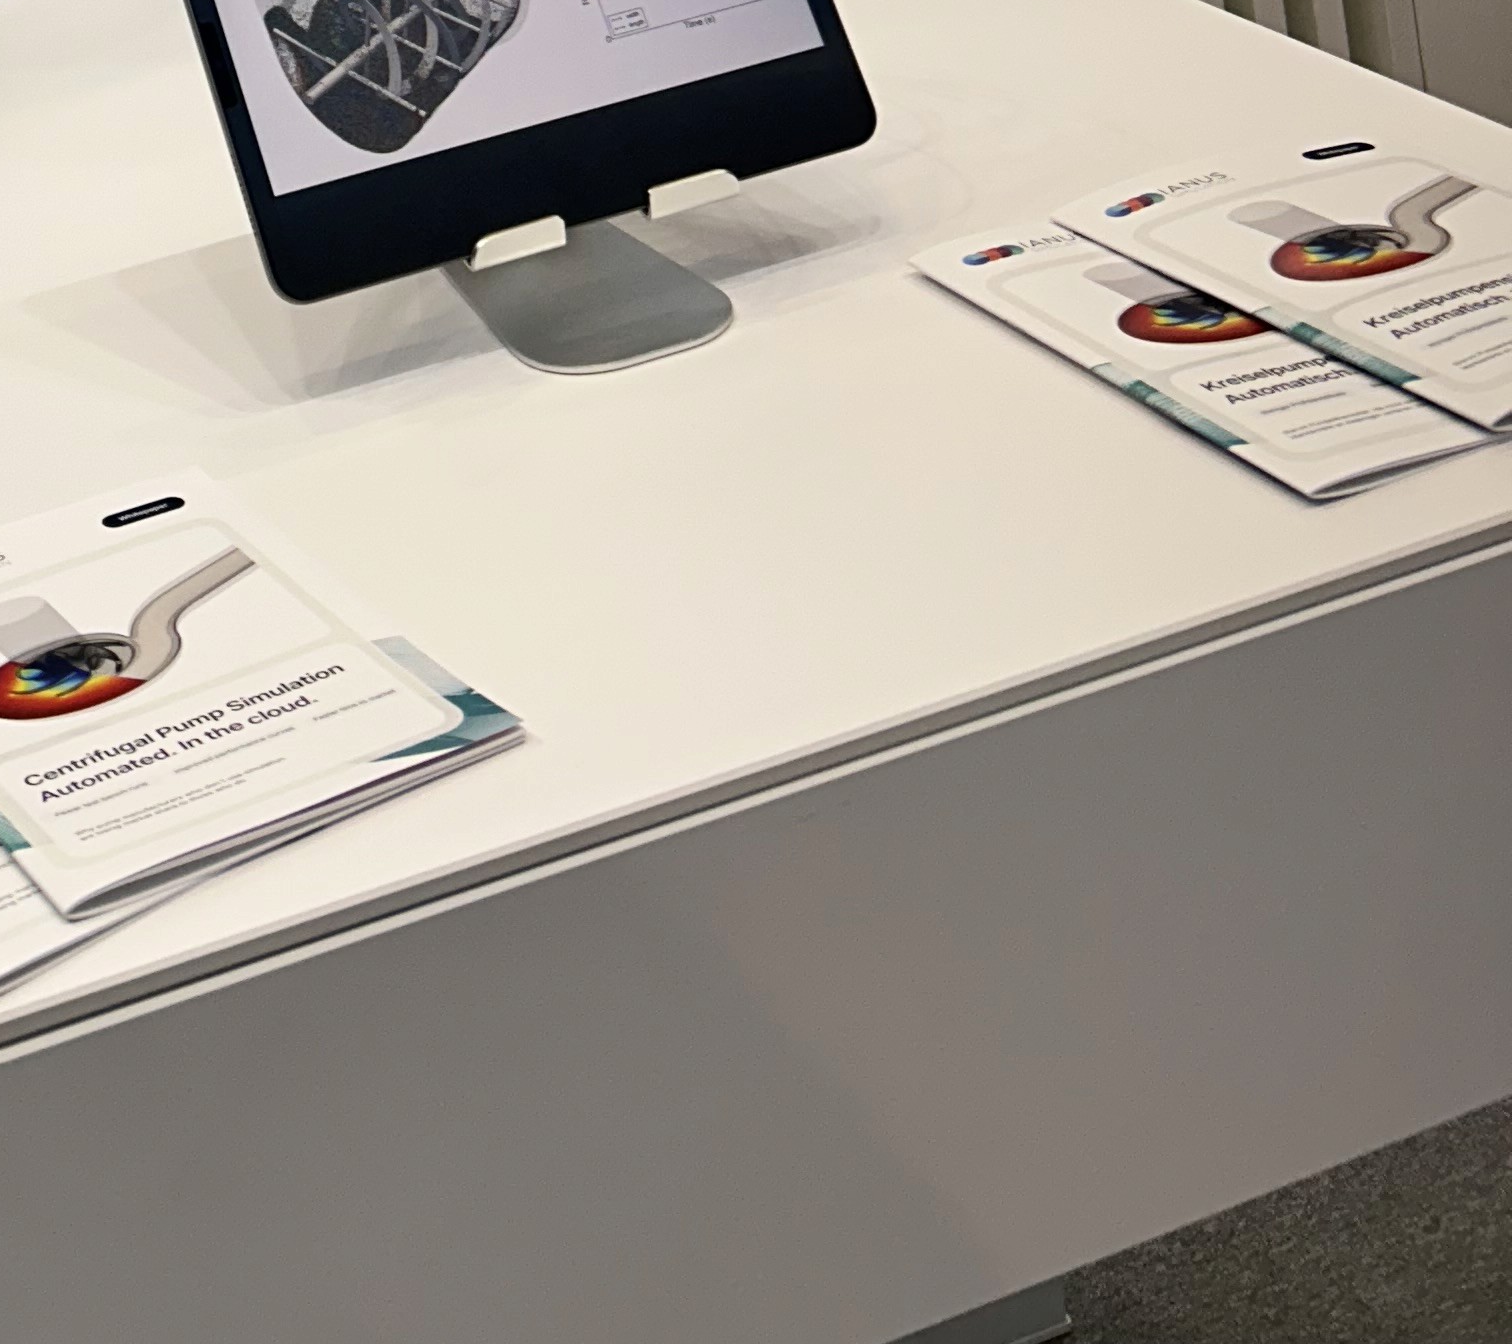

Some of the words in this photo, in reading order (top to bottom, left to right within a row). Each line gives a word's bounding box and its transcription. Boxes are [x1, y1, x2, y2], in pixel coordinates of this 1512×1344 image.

[1157, 171, 1228, 196] IANUS
[24, 732, 154, 787] Centrifugal
[156, 707, 225, 740] Pump
[226, 662, 345, 712] Simulation
[40, 747, 177, 803] Automated.
[178, 736, 197, 752] In
[204, 721, 245, 743] the
[247, 695, 319, 725] cloud.
